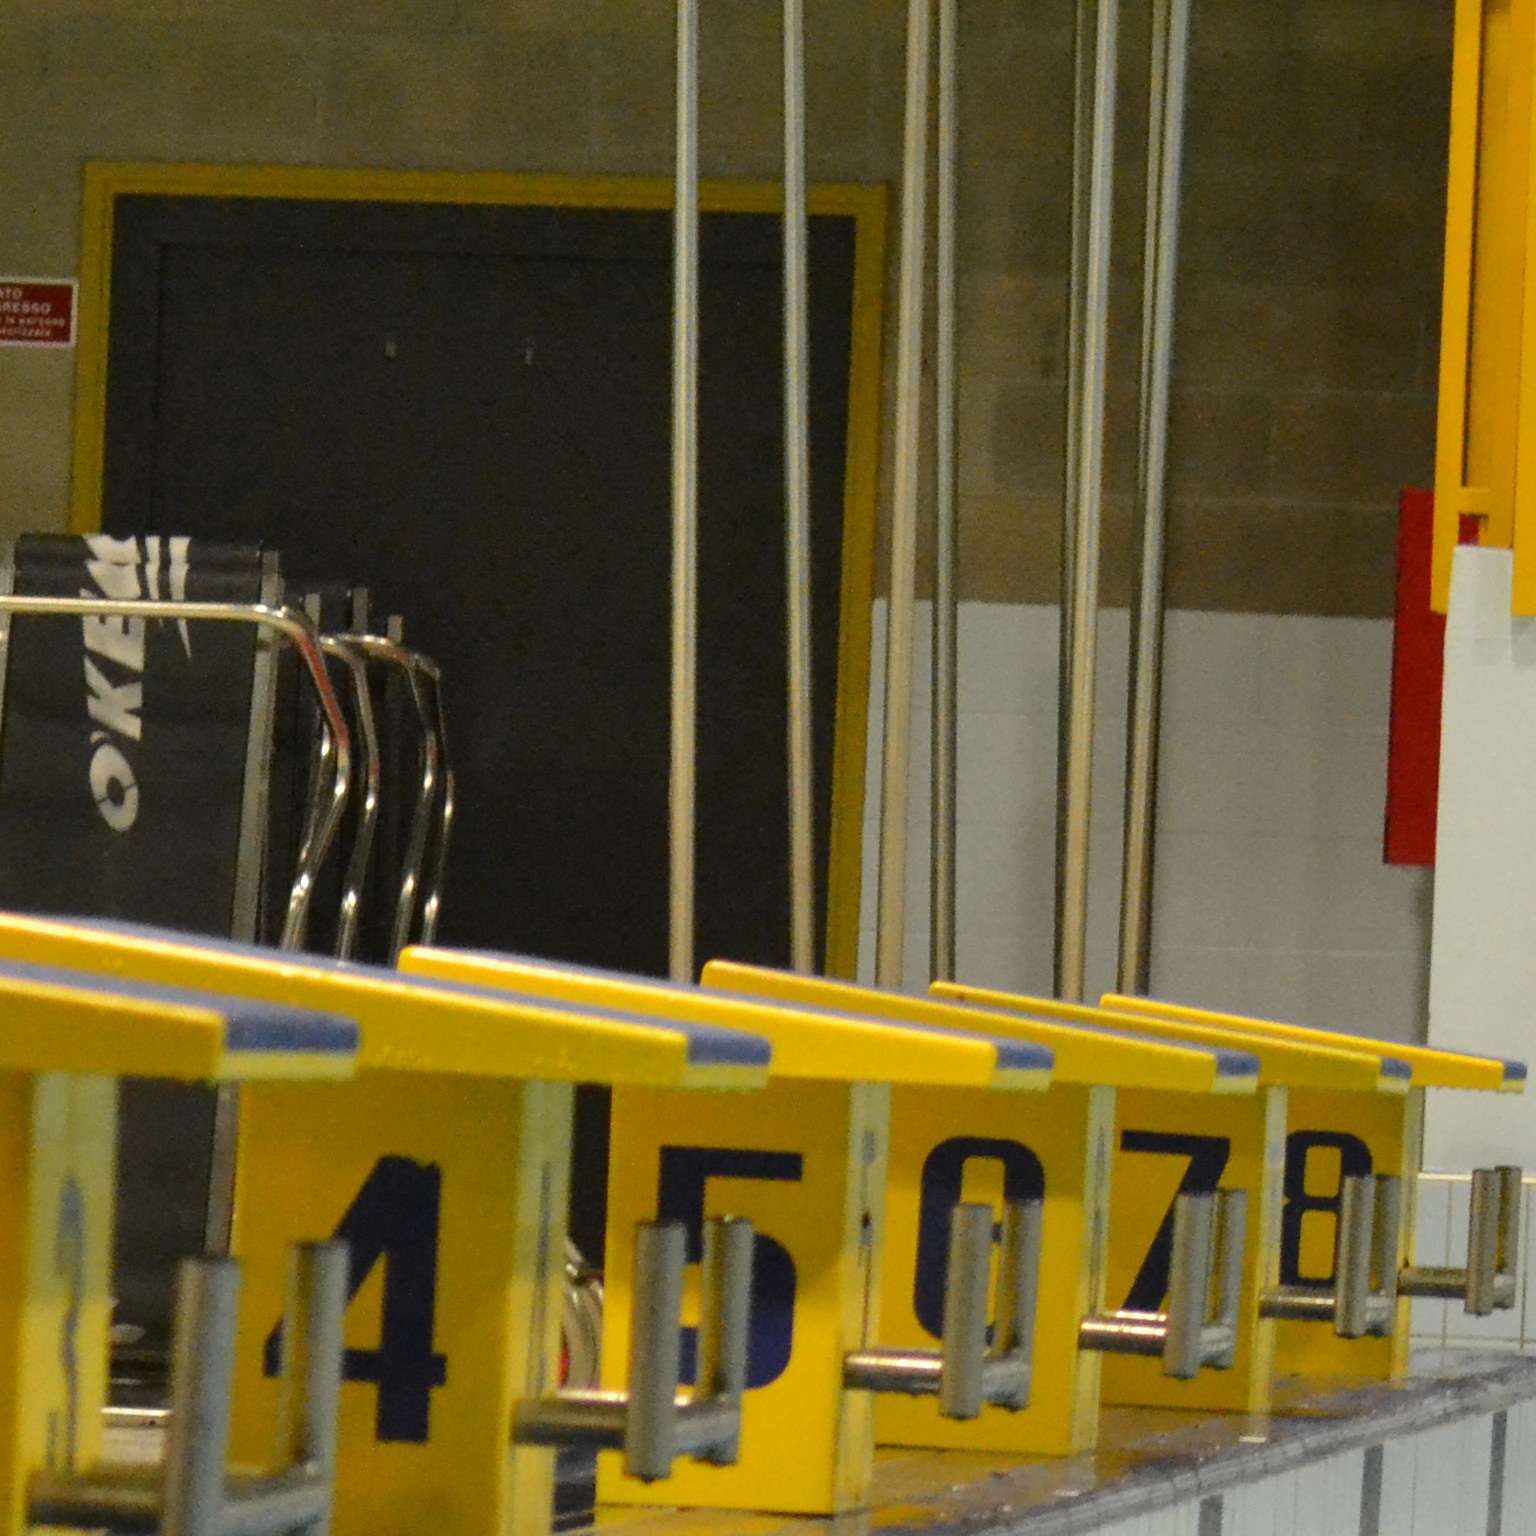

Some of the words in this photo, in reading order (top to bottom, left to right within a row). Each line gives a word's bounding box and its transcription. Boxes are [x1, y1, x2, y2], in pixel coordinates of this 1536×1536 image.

[263, 1152, 448, 1444] 4
[654, 1145, 804, 1391] 5
[1120, 1129, 1231, 1313] 7
[1280, 1129, 1374, 1290] 8
